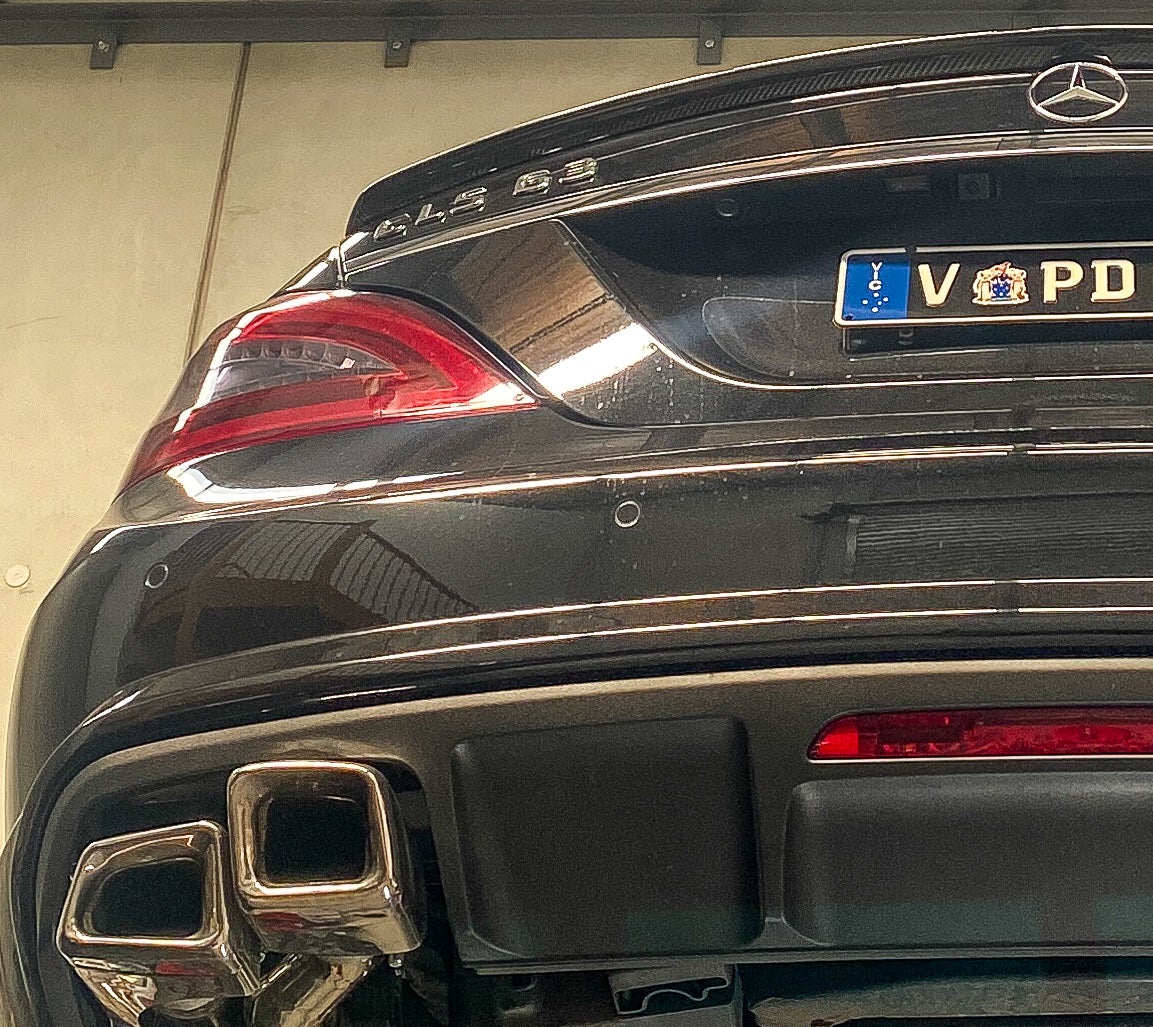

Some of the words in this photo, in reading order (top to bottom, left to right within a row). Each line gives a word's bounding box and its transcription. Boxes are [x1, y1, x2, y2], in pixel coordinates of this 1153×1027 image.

[373, 186, 488, 242] CLS
[917, 263, 961, 309] V
[1042, 258, 1137, 305] PD
